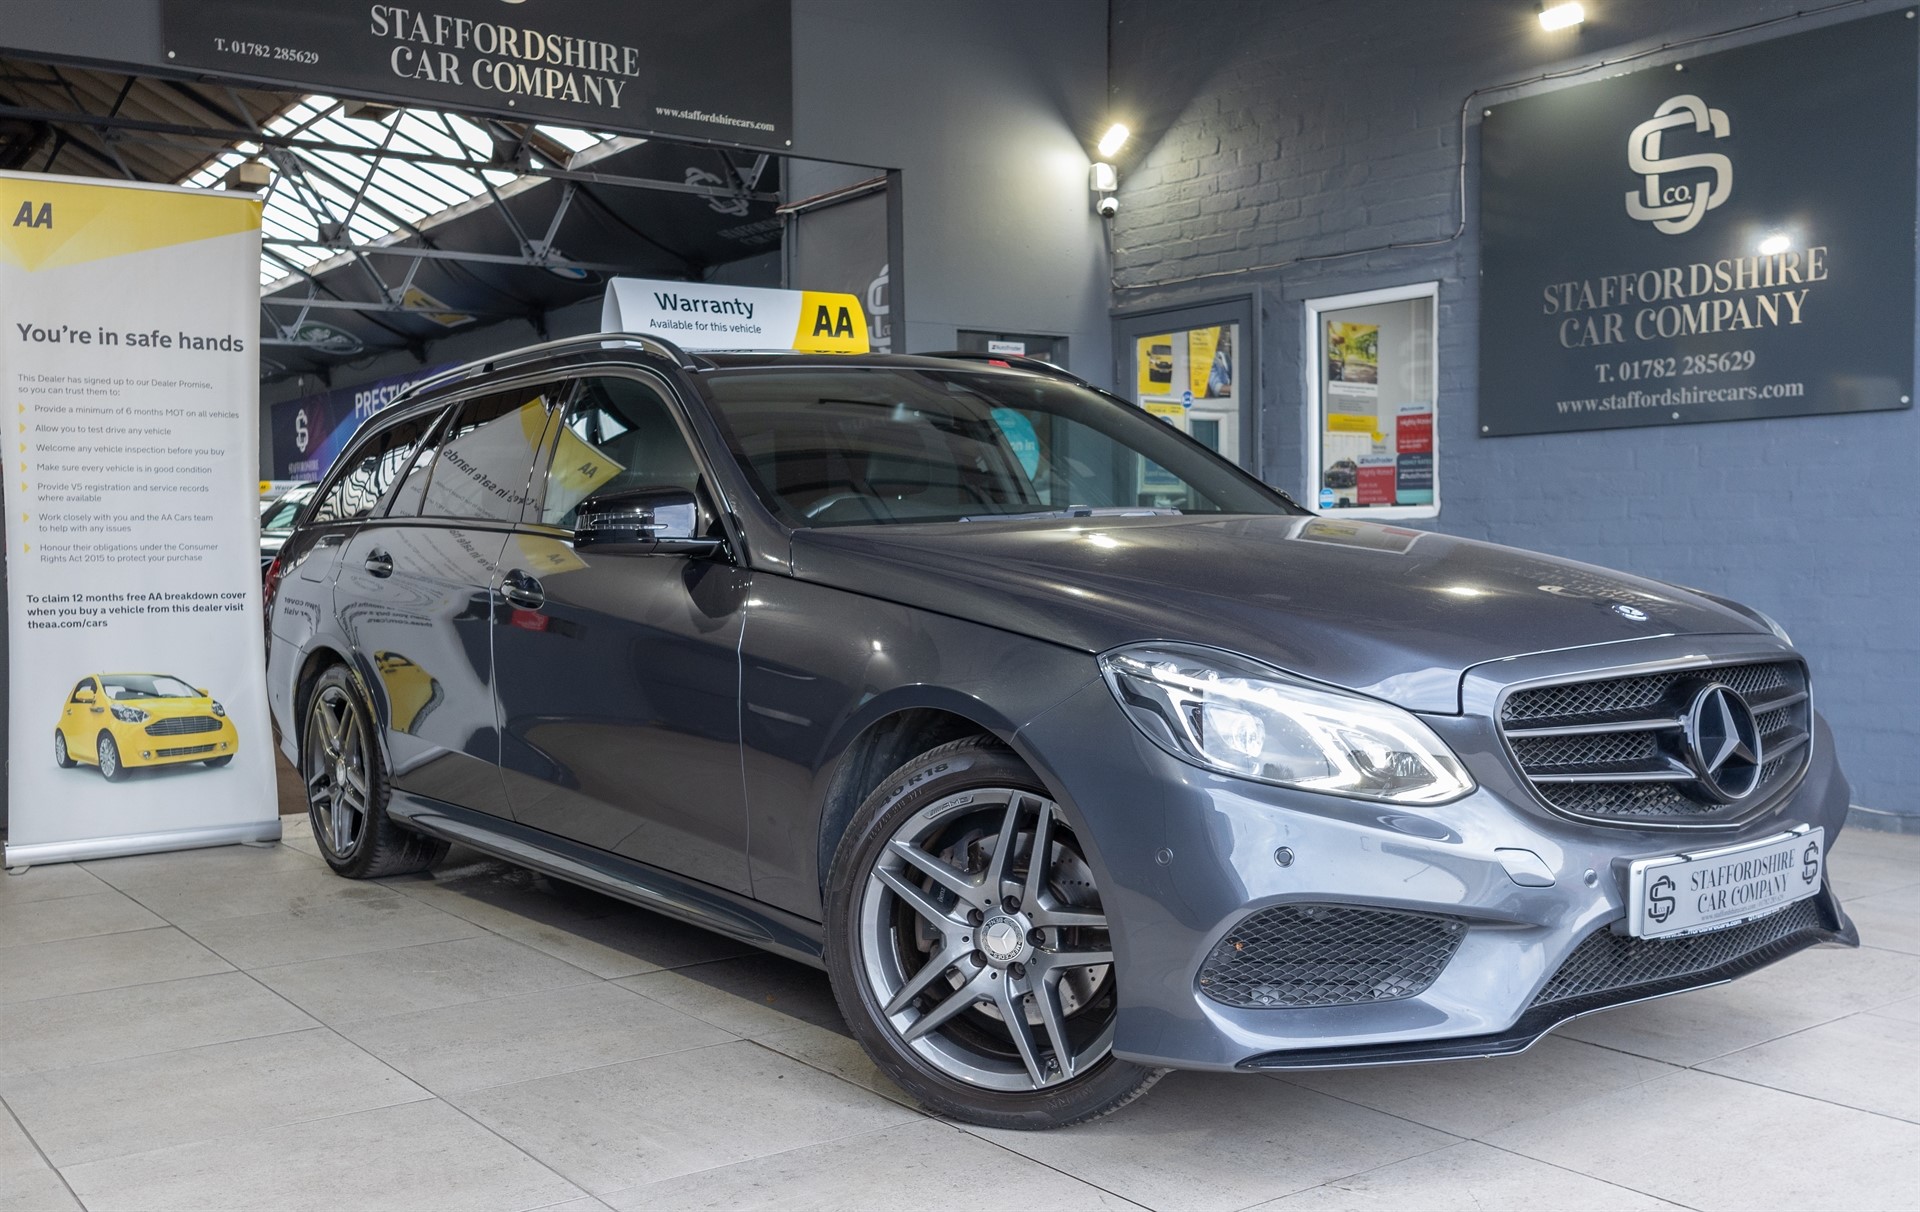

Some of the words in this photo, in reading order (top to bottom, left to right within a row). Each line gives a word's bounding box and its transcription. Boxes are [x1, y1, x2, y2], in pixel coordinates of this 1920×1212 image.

[370, 4, 640, 77] STAFFORDSHIRE
[215, 38, 228, 51] T.
[232, 41, 270, 57] 01782
[274, 47, 319, 64] 285629
[391, 45, 463, 86] CAR
[472, 59, 626, 109] COMPANY
[656, 107, 774, 132] www.staffordshirecars.com
[13, 201, 52, 229] AA
[1543, 246, 1829, 315] STAFFORDSHIRE
[654, 292, 754, 318] Warranty
[650, 319, 692, 330] Available
[695, 320, 708, 331] for
[710, 322, 727, 332] this
[729, 324, 761, 334] vehicle
[812, 305, 854, 339] AA
[1559, 313, 1626, 349] CAR
[1635, 289, 1810, 340] COMPANY
[17, 324, 91, 345] You're
[99, 327, 118, 345] in
[125, 330, 172, 348] safe
[179, 332, 244, 352] hands
[1595, 364, 1615, 383] T.
[1619, 358, 1676, 381] 01782
[1682, 350, 1756, 375] 285629
[18, 374, 35, 383] This
[38, 374, 65, 384] Dealer
[84, 377, 111, 386] signed
[114, 378, 124, 386] up
[179, 381, 212, 389] Promise,
[31, 387, 46, 396] you
[65, 387, 84, 395] trust
[86, 388, 107, 396] them
[355, 380, 420, 419] PRESTI
[1556, 382, 1804, 414] www.staffordshirecars.com
[35, 405, 66, 413] Provide
[35, 424, 58, 432] Allow
[61, 426, 75, 435] you
[36, 444, 75, 452] Welcome
[78, 446, 92, 454] any
[125, 446, 165, 455] inspection
[210, 448, 224, 456] buy
[37, 464, 59, 472] Make
[82, 465, 104, 474] every
[154, 466, 174, 475] good
[38, 483, 69, 491] Provide
[85, 484, 131, 492] registration
[39, 514, 61, 522] Work
[63, 514, 91, 523] closely
[113, 515, 128, 523] you
[50, 524, 68, 533] help
[93, 543, 137, 552] obligations
[40, 555, 66, 564] Rights
[118, 554, 146, 563] protect
[148, 555, 164, 563] your
[167, 554, 202, 562] purchase
[26, 594, 39, 603] To
[42, 594, 70, 602] claim
[86, 593, 124, 602] months
[126, 592, 146, 601] free
[148, 592, 162, 600] AA
[164, 592, 218, 600] breakdown
[27, 608, 56, 616] when
[58, 608, 77, 617] you
[79, 606, 98, 616] buy
[108, 605, 144, 614] vehicle
[147, 605, 170, 613] from
[172, 604, 190, 613] this
[192, 603, 222, 612] dealer
[224, 603, 244, 611] visit
[28, 619, 108, 629] theaa.com/cars
[1690, 849, 1795, 891] STAFFORDSHIRE
[1698, 890, 1726, 913] CAR
[1732, 873, 1789, 906] COMPANY
